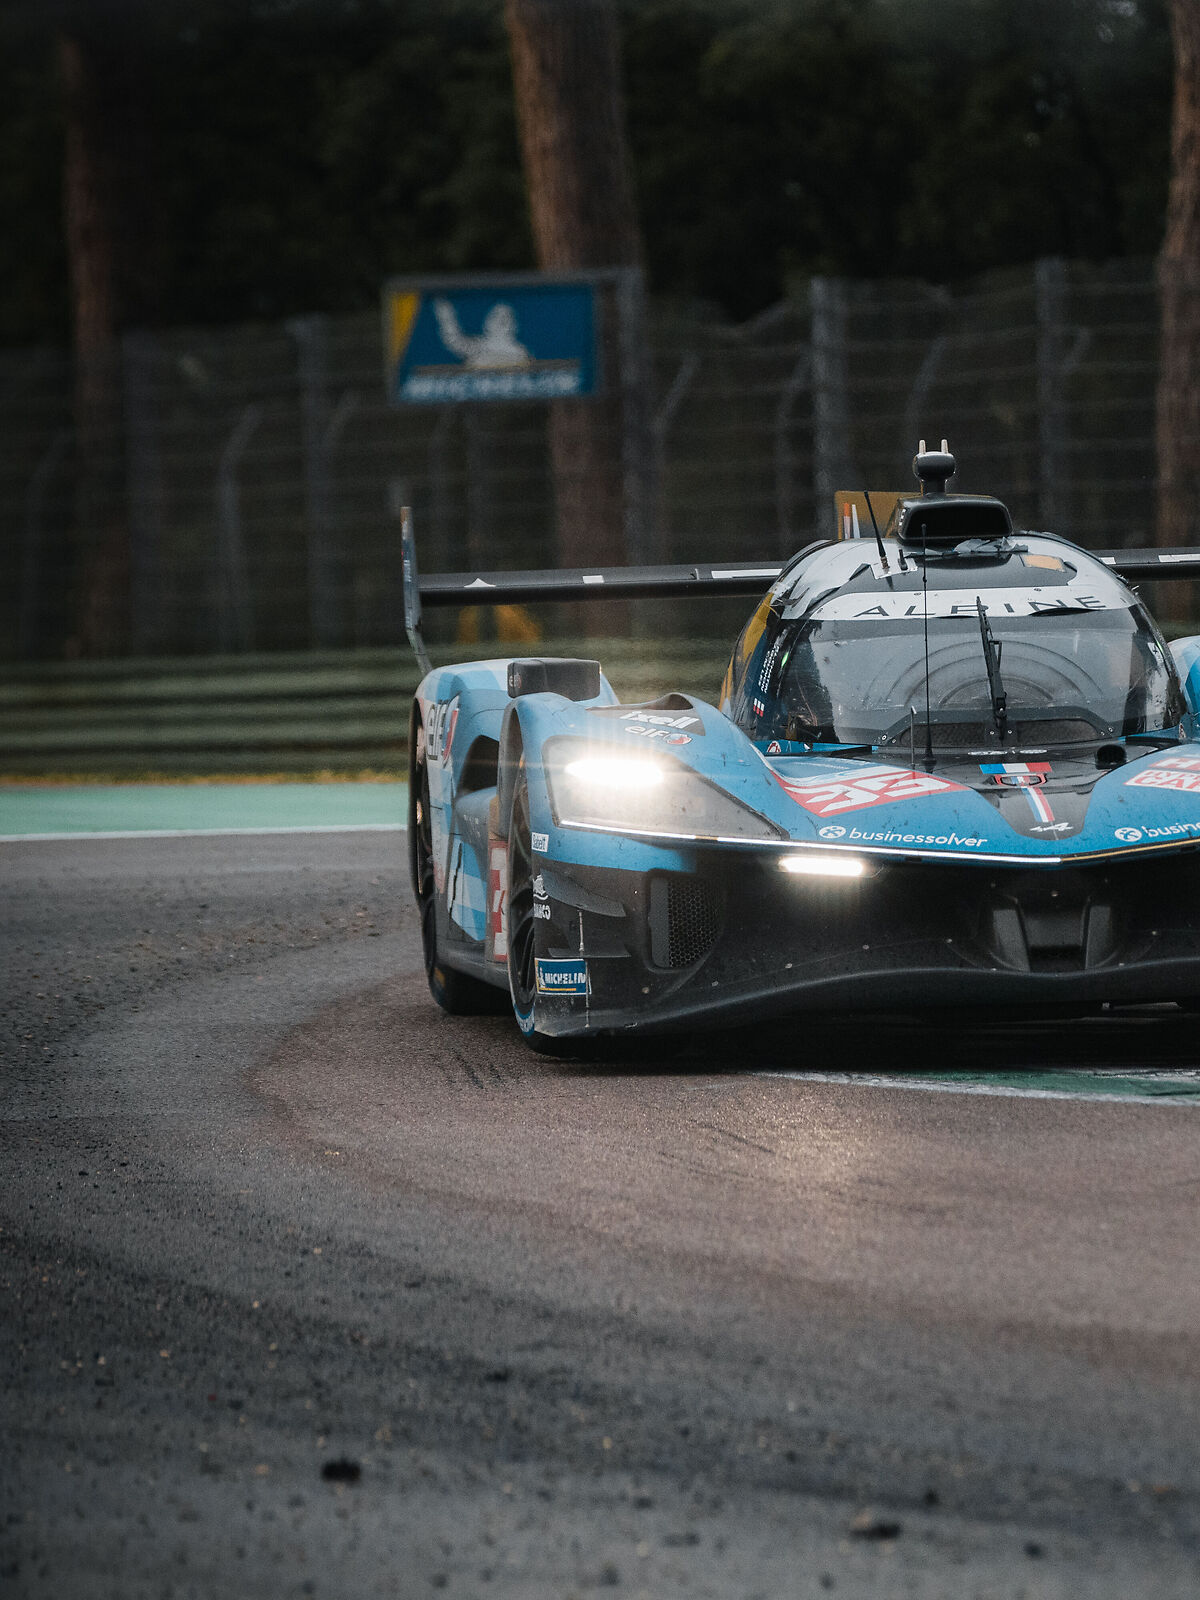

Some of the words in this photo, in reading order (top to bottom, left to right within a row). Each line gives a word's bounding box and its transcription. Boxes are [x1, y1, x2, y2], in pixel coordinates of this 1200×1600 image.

[853, 596, 1106, 617] ALPINE
[427, 703, 447, 756] elf
[620, 711, 699, 729] ixell
[625, 726, 670, 738] elf
[850, 828, 988, 848] businessolver
[545, 972, 587, 985] MICHELIN
